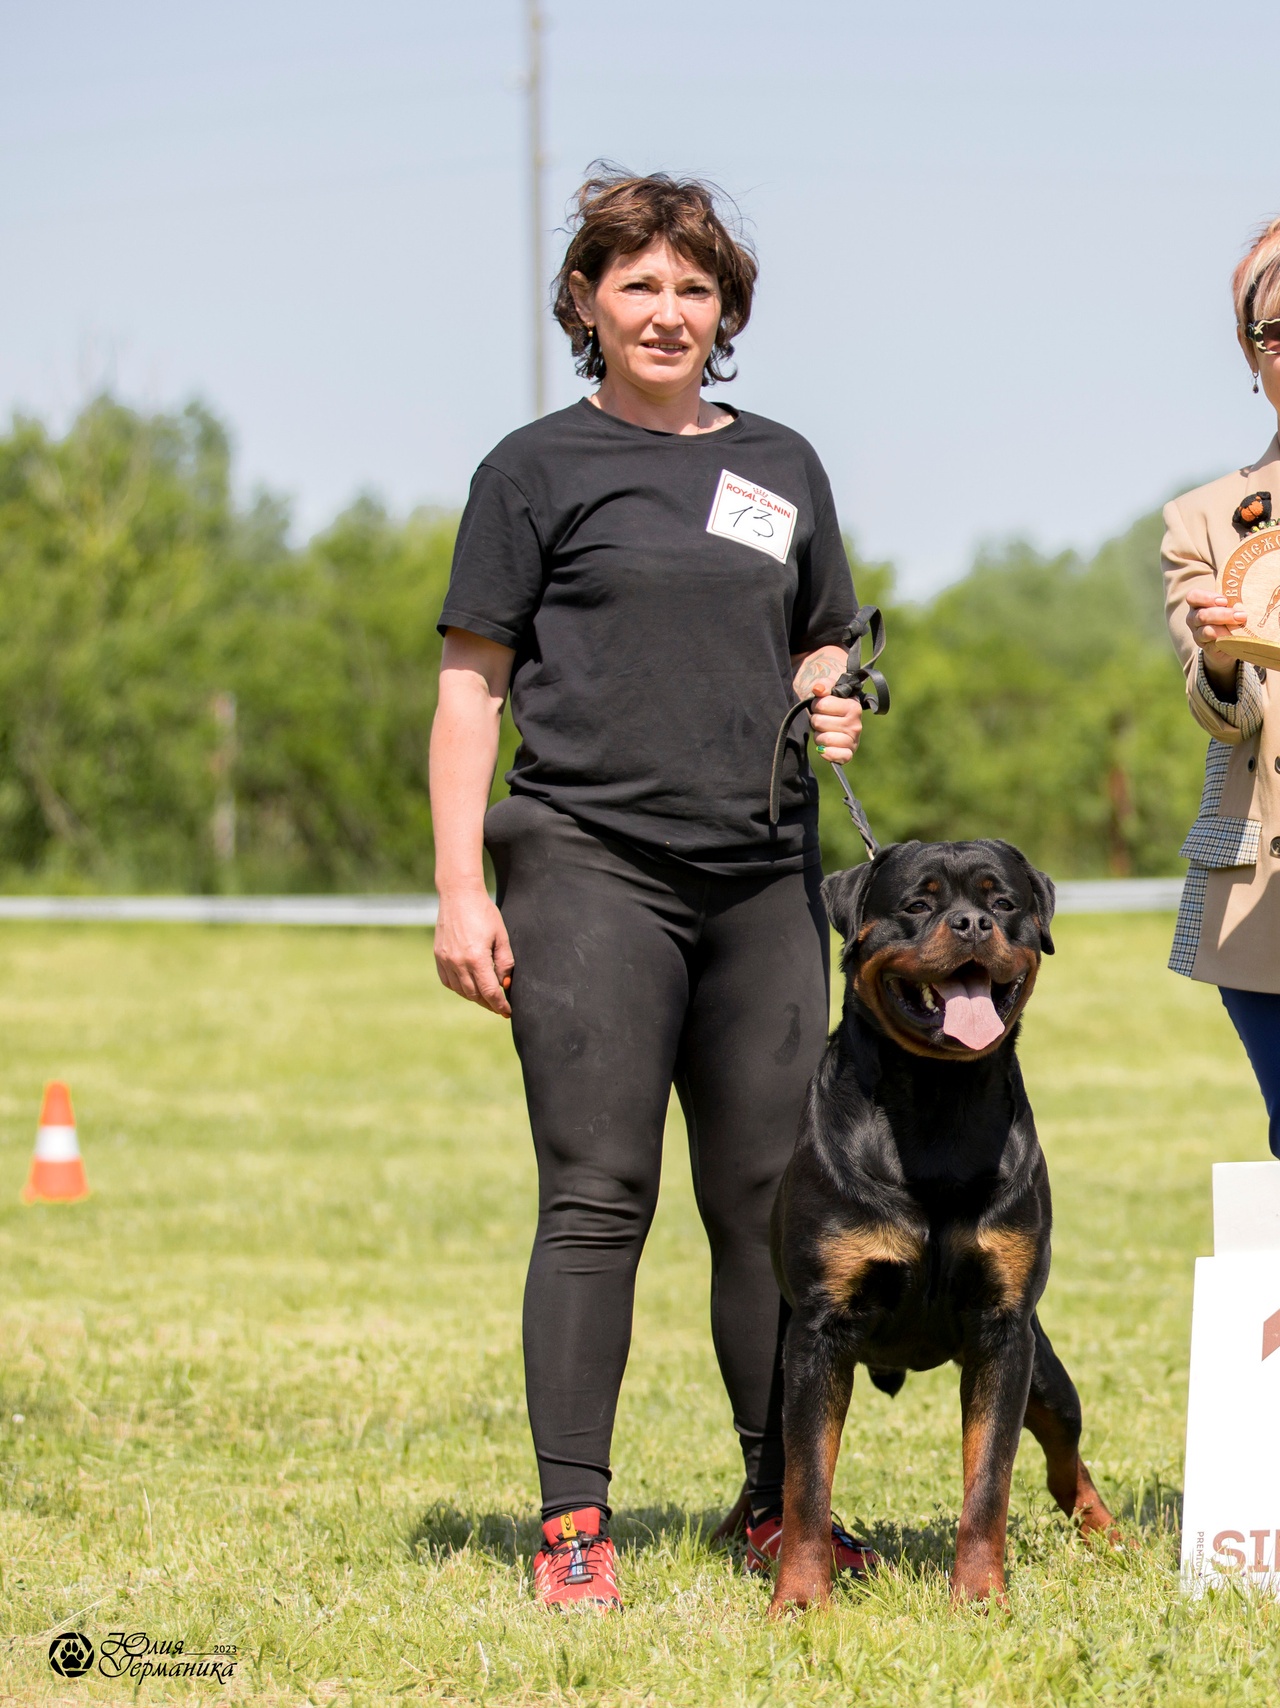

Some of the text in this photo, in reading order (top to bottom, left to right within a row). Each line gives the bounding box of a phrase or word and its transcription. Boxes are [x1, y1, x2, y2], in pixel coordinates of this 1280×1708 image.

[726, 483, 791, 518] ROYAL CANIN
[729, 506, 774, 538] 13
[1195, 1531, 1205, 1571] PREMIU
